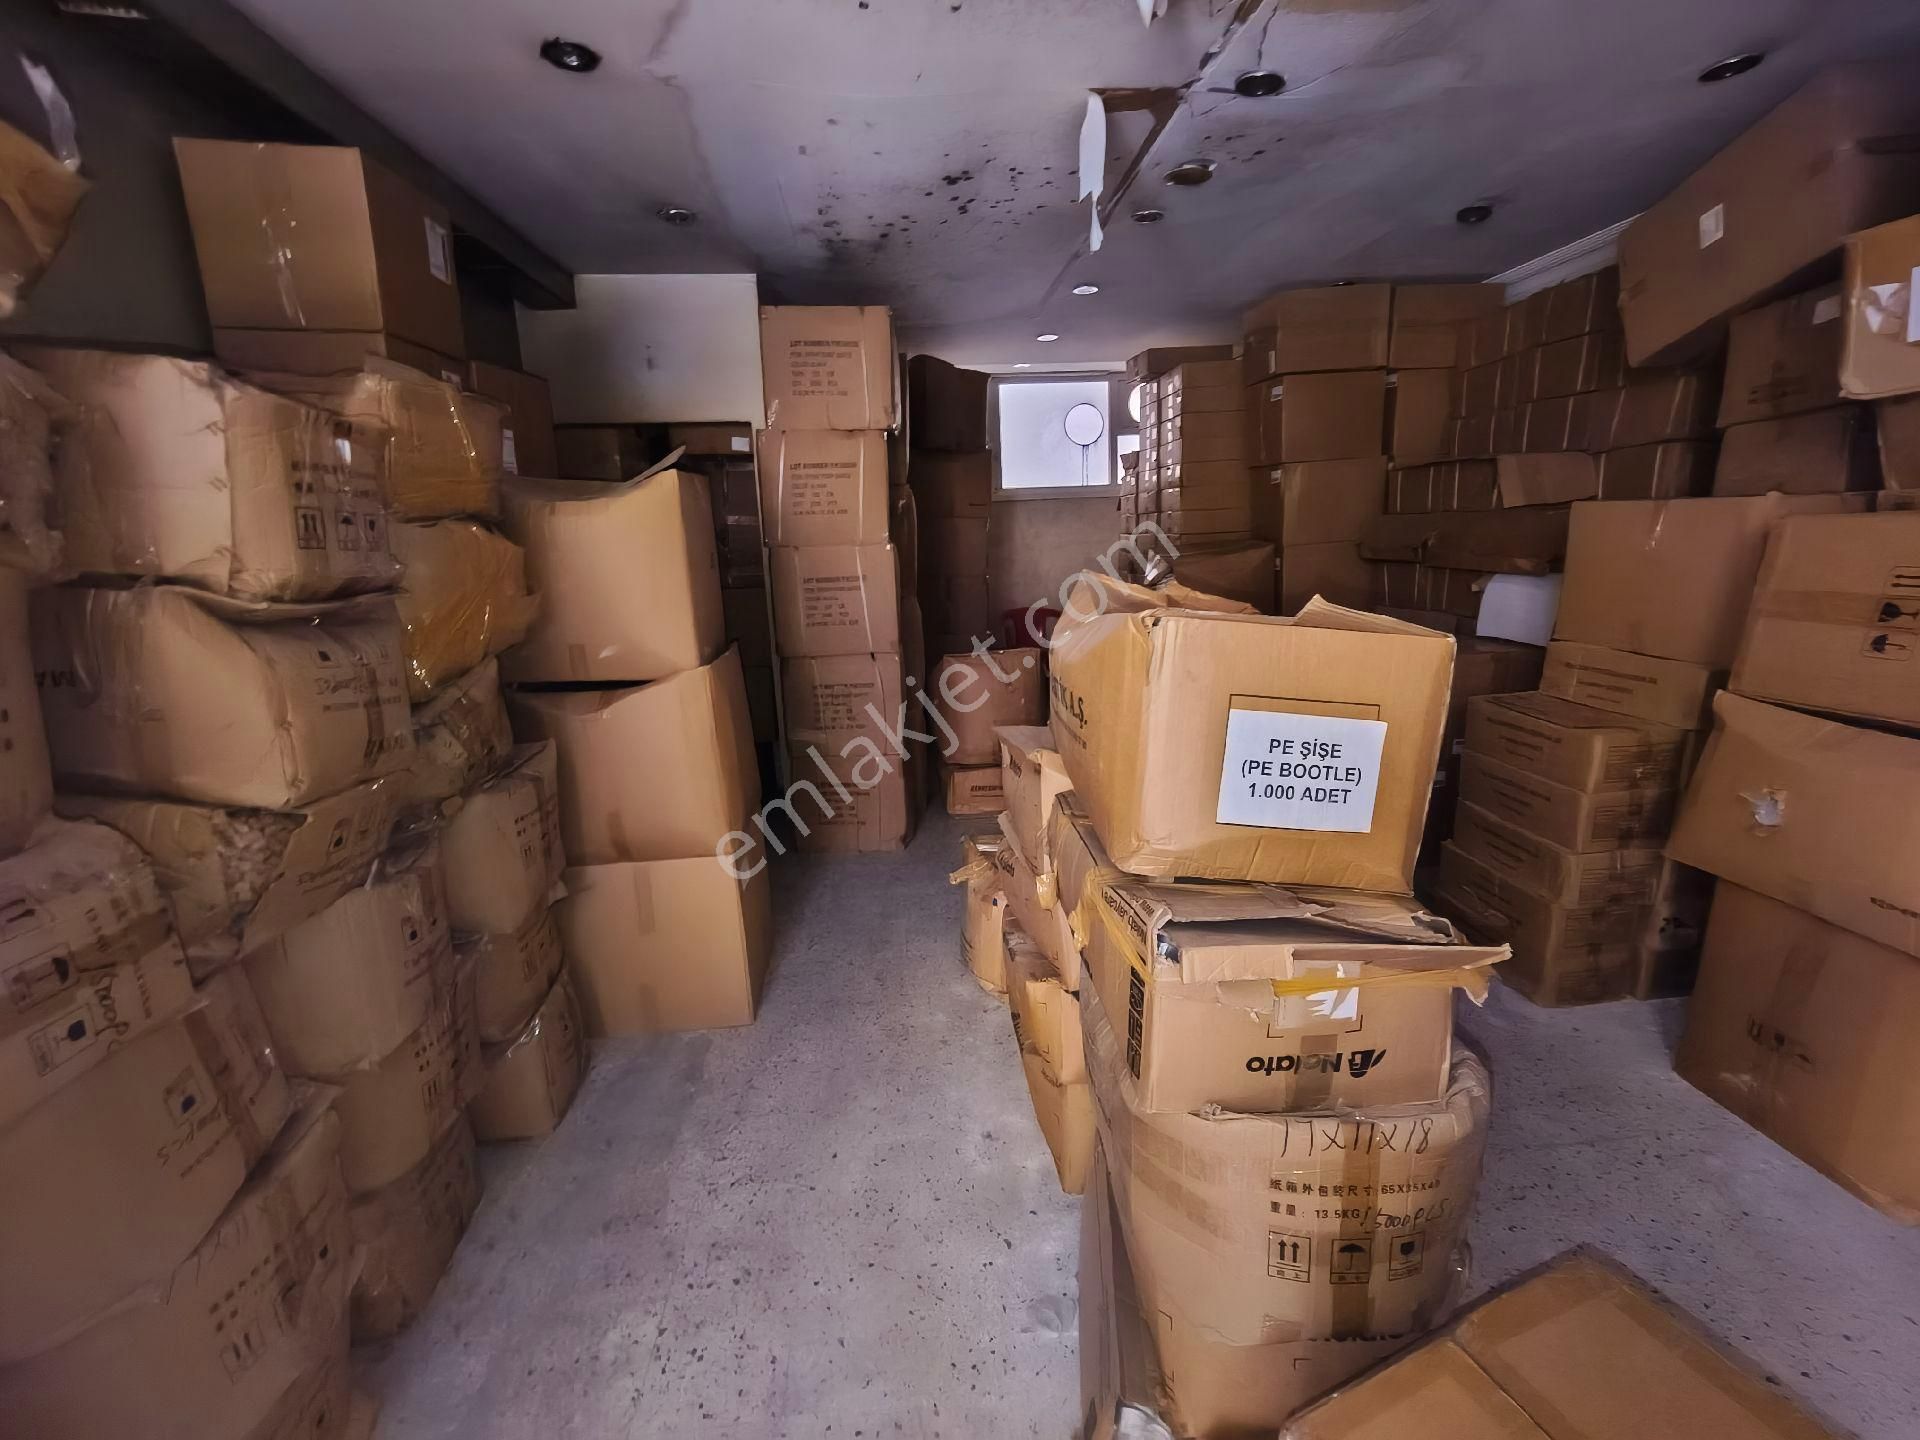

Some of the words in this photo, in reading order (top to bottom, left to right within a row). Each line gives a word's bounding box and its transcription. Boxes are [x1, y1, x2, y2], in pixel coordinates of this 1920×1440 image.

[1269, 738, 1295, 755] PE
[1299, 738, 1343, 761] ŞİŞE
[1241, 759, 1274, 778] (PE
[1279, 762, 1362, 787] BOOTLE)
[1248, 782, 1295, 800] 1.000
[1300, 786, 1352, 804] ADET
[1245, 1052, 1344, 1077] Nolato
